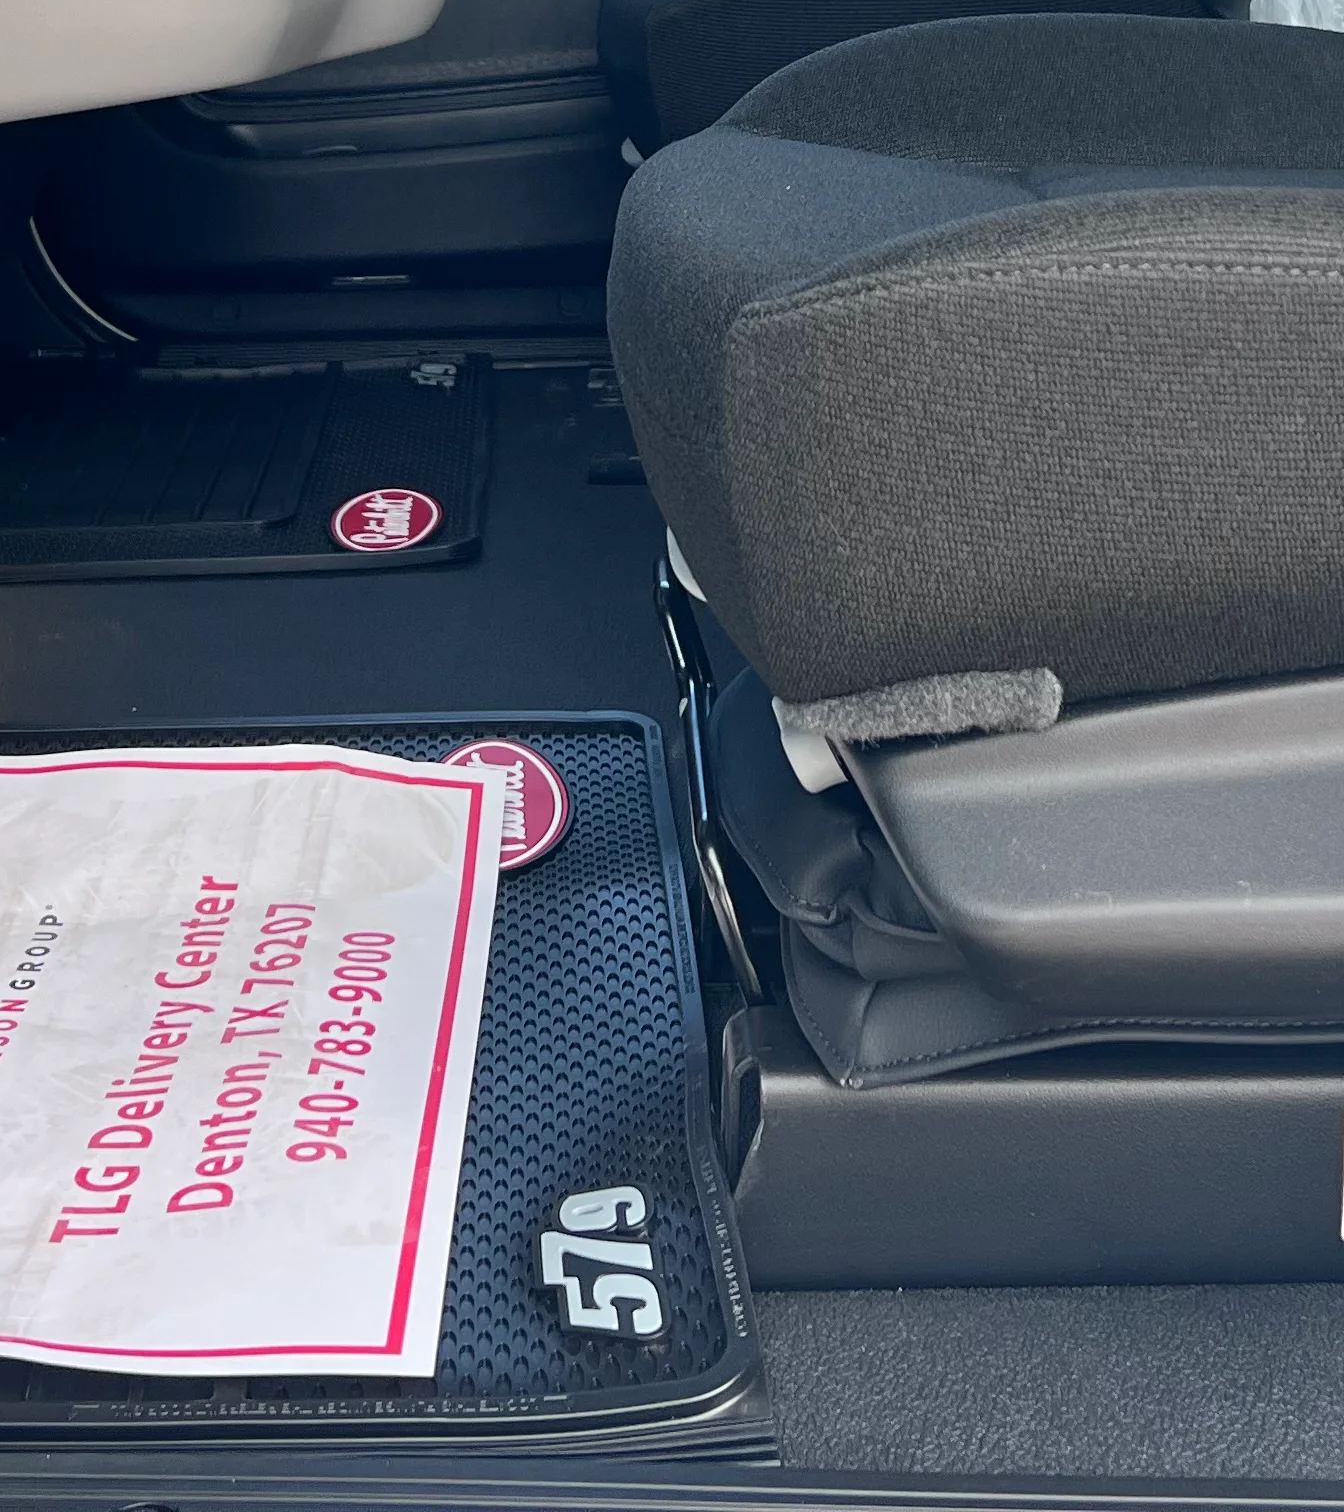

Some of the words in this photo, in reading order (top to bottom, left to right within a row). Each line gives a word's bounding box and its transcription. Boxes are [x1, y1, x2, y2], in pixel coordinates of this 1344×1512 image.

[156, 875, 239, 989] Center
[241, 904, 316, 995] 76207
[88, 1000, 215, 1150] Delivery
[222, 999, 289, 1044] TX
[286, 932, 395, 1162] 940-783-9000
[167, 1050, 282, 1213] Denton,
[49, 1165, 140, 1243] TLG
[541, 1186, 663, 1335] 579
